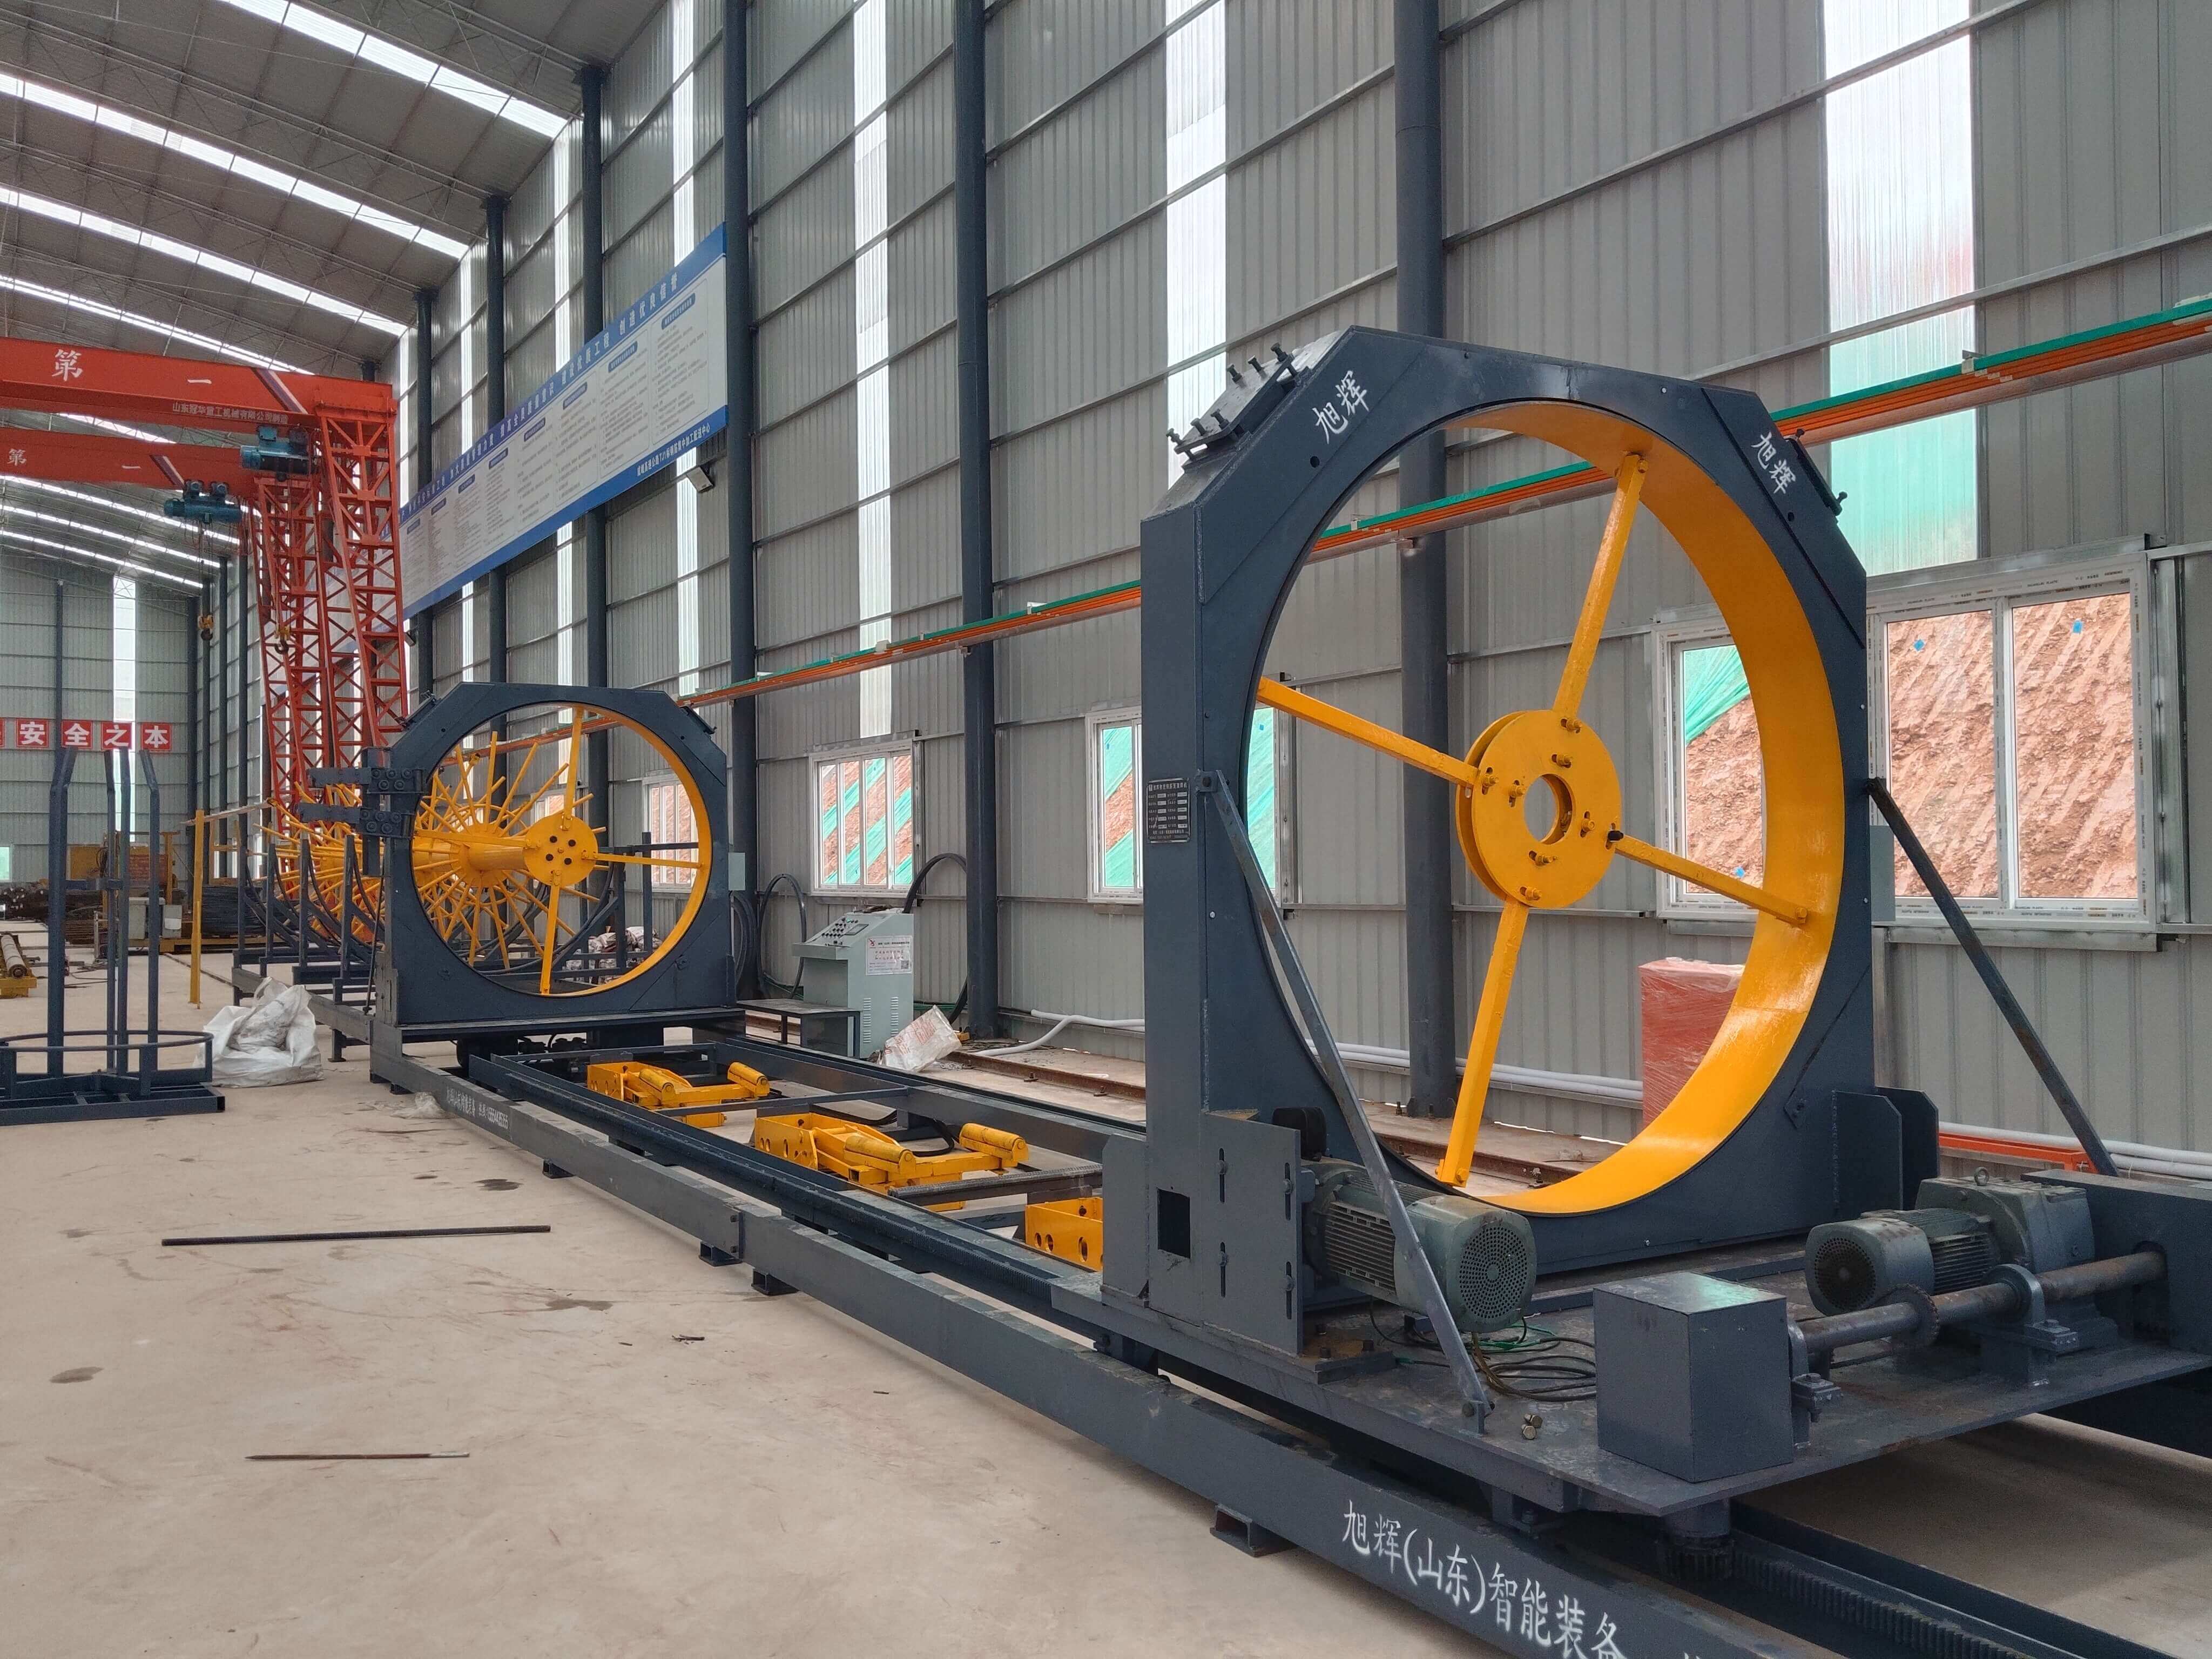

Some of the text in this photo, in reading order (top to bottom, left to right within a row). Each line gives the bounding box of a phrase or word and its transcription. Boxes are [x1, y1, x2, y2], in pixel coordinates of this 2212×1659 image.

[1311, 370, 1370, 444] 旭辉
[1751, 431, 1796, 495] 旭辉
[19, 721, 168, 748] 安全之本
